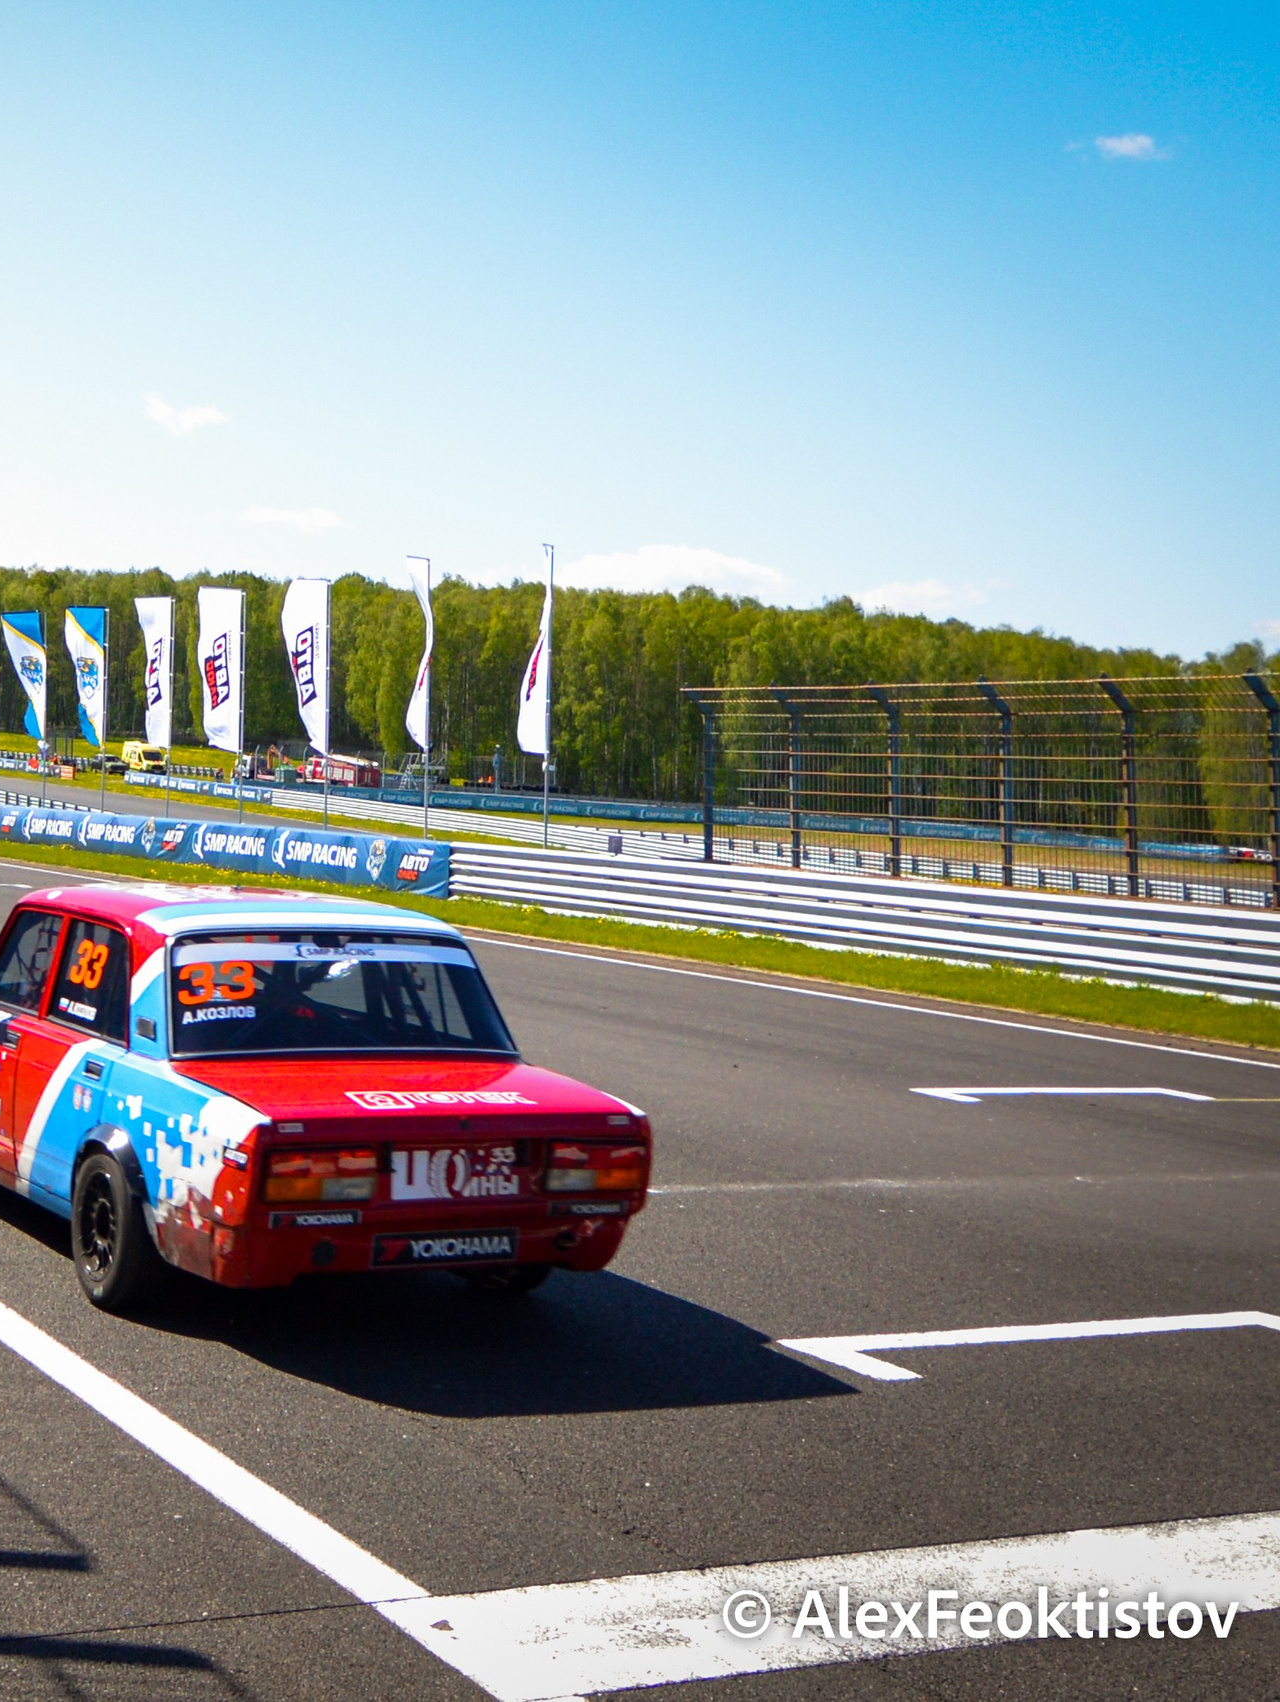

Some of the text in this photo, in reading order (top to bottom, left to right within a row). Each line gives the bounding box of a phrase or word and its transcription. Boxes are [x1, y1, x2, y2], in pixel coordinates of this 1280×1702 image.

[30, 818, 46, 834] SMP
[46, 818, 73, 837] RACING
[86, 822, 136, 844] SMP RACING
[203, 831, 226, 853] SMP
[225, 834, 266, 857] RACING
[285, 840, 358, 868] SMP RACING
[399, 854, 430, 872] АВТО
[69, 938, 109, 989] 33
[177, 960, 256, 1006] 33
[182, 1005, 257, 1025] А.КОЗЛОВ
[294, 1212, 354, 1226] YOKOHAMA
[410, 1235, 513, 1259] YOKOHAMA
